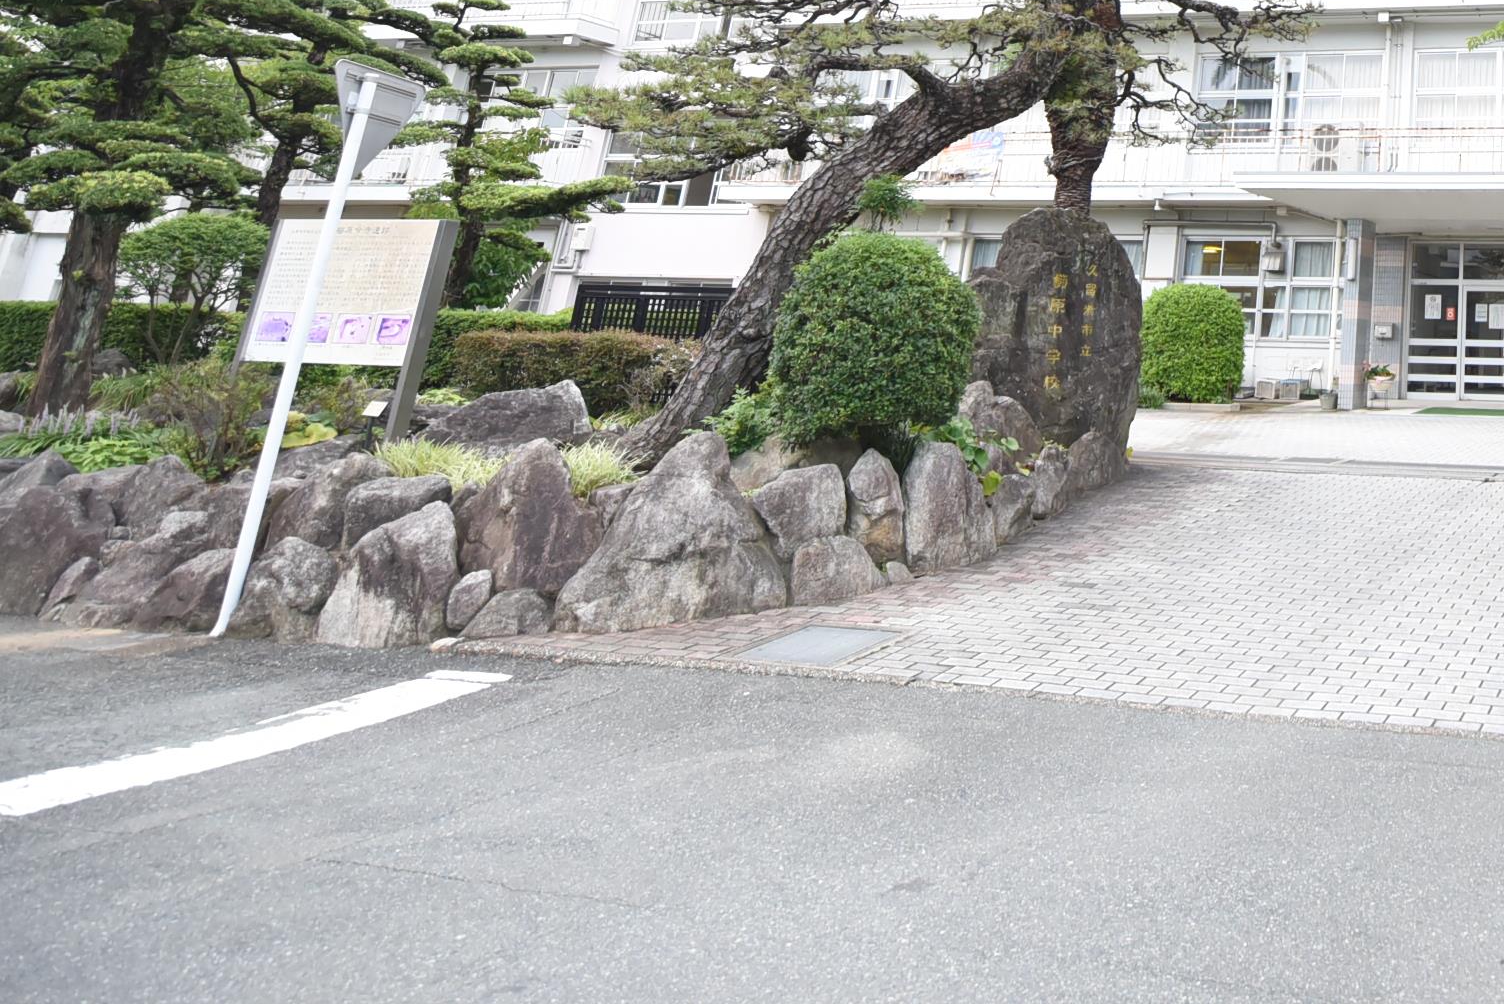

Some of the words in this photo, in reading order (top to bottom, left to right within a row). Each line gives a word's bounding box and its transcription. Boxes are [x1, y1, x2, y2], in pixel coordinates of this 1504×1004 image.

[1080, 263, 1098, 357] 久留米市立
